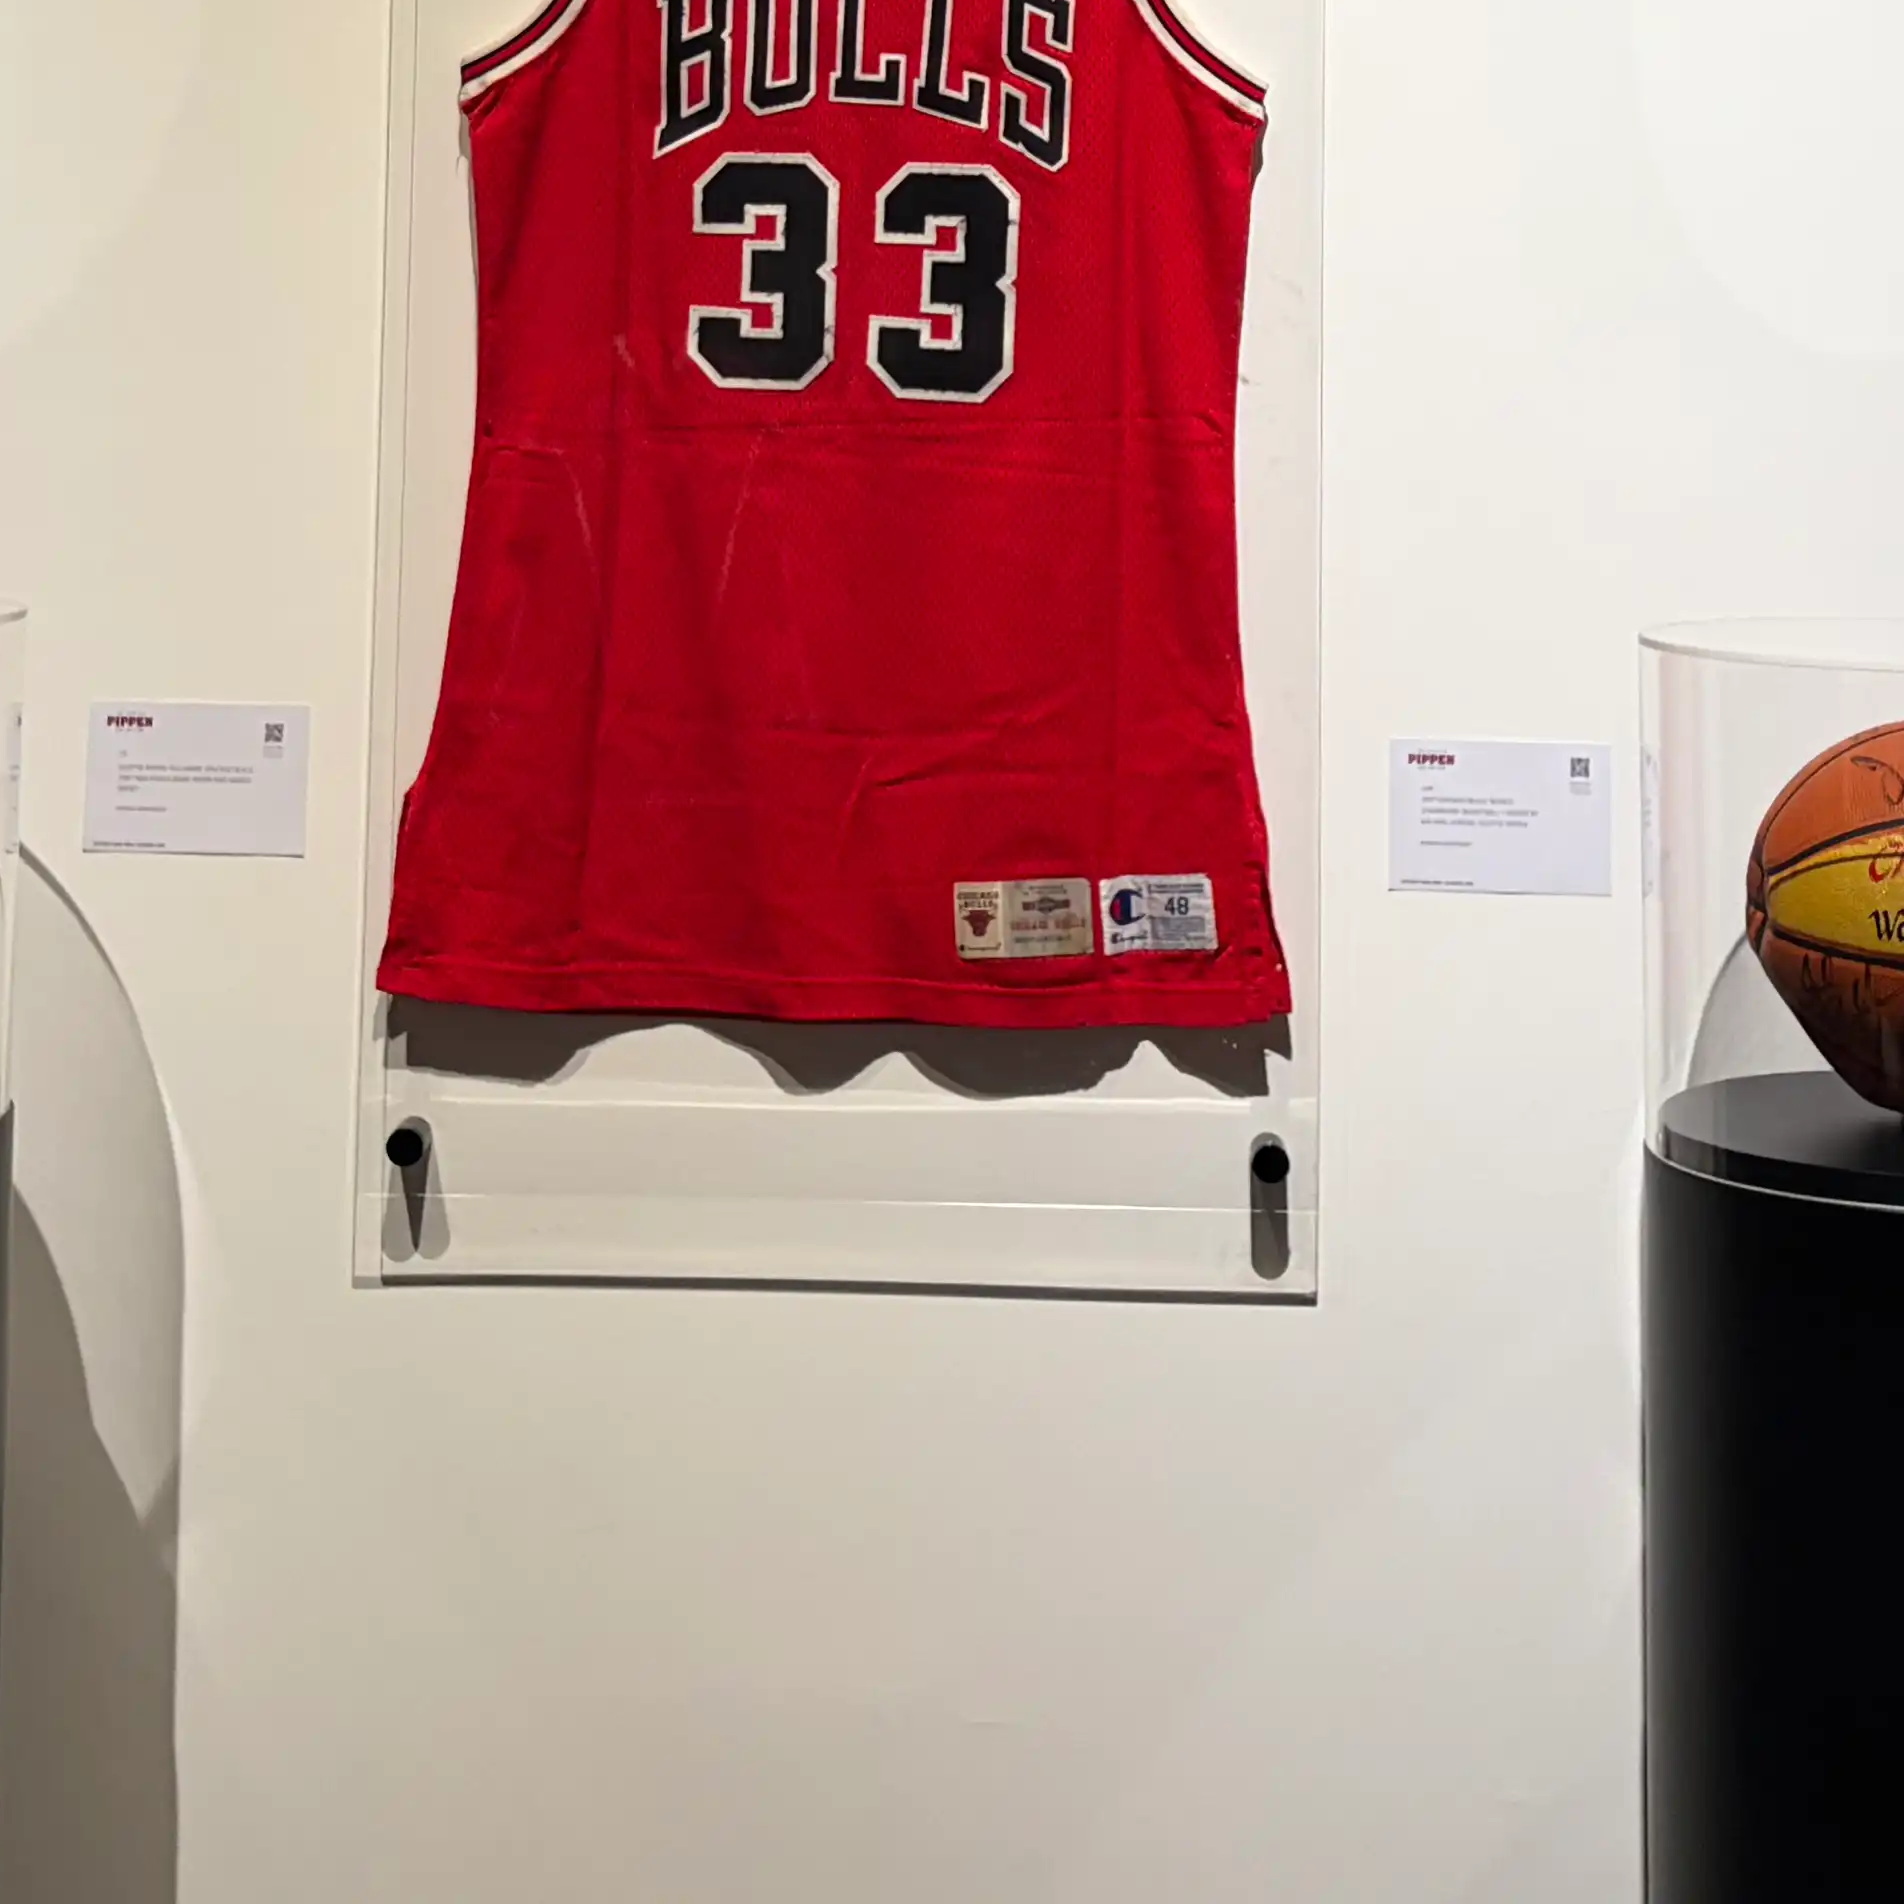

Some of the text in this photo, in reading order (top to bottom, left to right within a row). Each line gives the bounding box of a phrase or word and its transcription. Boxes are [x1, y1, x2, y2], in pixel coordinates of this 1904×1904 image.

[686, 152, 1021, 403] 33
[107, 715, 153, 727] PIPPEN
[1408, 753, 1455, 765] PIPPEN
[1165, 896, 1189, 915] 48
